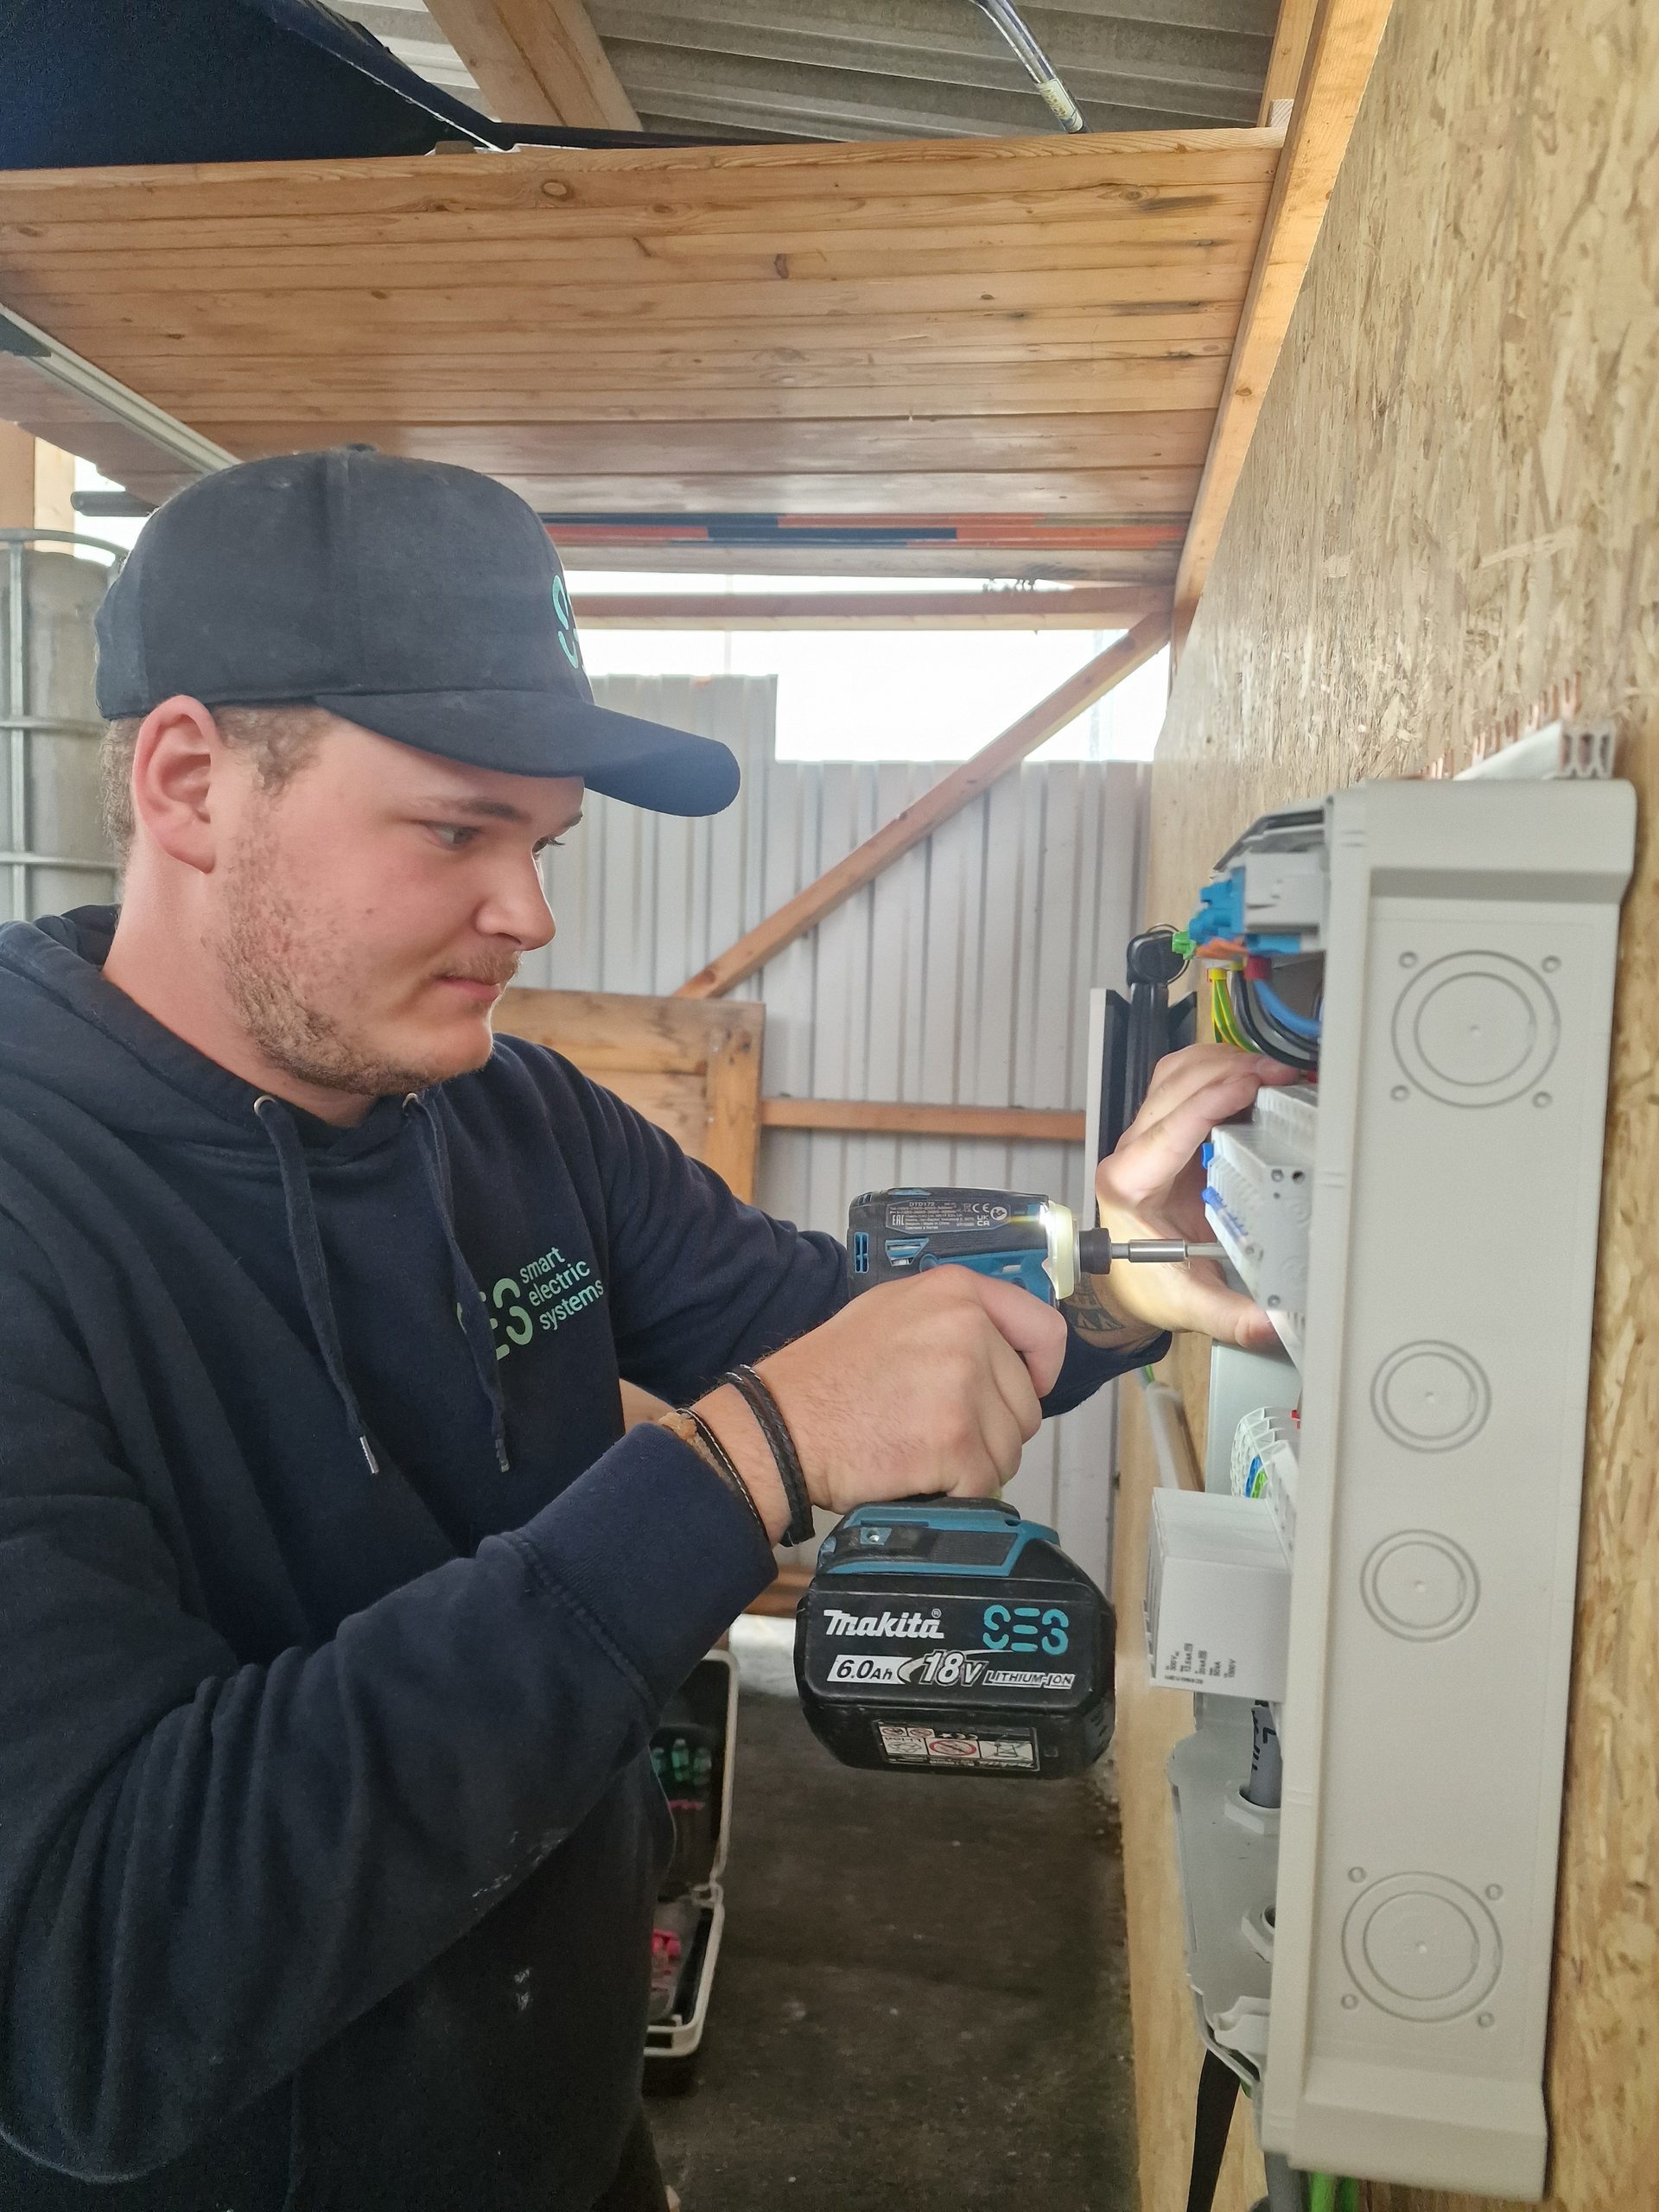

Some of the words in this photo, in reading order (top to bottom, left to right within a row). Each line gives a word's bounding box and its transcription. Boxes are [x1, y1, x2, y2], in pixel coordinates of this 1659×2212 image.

[972, 1203, 990, 1213] CE
[519, 1247, 566, 1284] smart
[528, 1260, 591, 1306] electric
[539, 1279, 604, 1331] systems
[836, 1659, 893, 1681] 6.0Ah
[985, 1670, 1074, 1688] LITHIUM-ION
